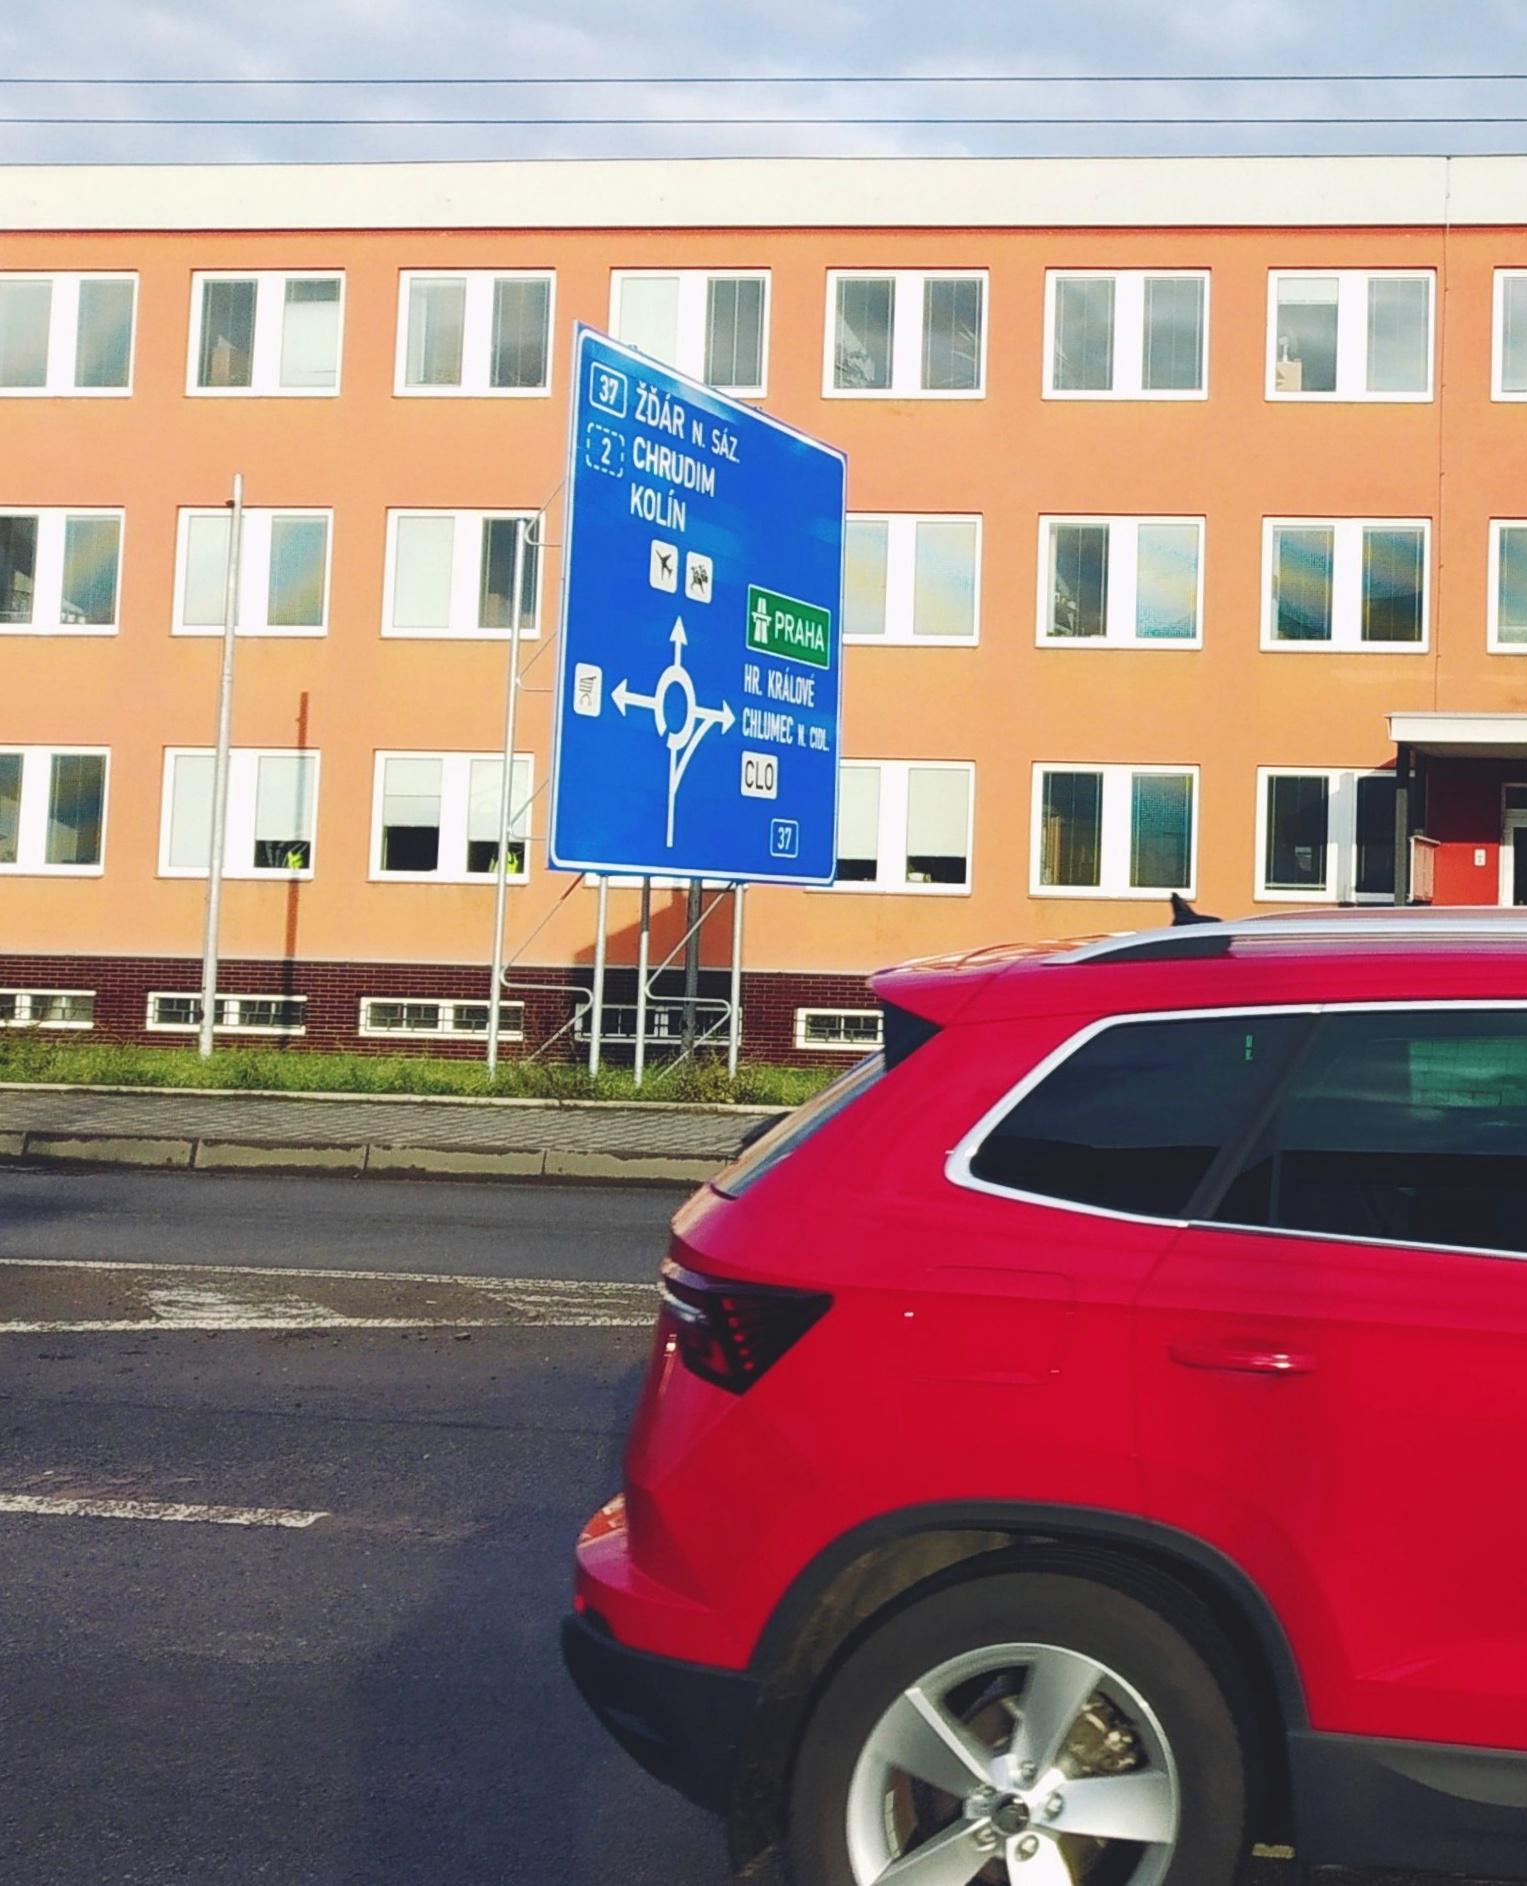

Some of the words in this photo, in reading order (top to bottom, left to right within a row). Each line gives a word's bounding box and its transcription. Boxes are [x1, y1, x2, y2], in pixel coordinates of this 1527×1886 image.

[599, 374, 618, 405] 37
[635, 380, 685, 439] ŽĎÁR
[692, 420, 706, 448] N.
[712, 428, 740, 463] SÁZ.
[601, 438, 612, 464] 2
[633, 436, 716, 497] CHRUDIM
[630, 483, 686, 532] KOLÍN
[774, 611, 824, 651] PRAHA
[744, 663, 763, 696] HR.
[767, 666, 815, 708] KRÁLOVÉ
[742, 707, 794, 743] CHLUMEC
[810, 726, 829, 751] CIDL.
[745, 760, 773, 790] CLO
[777, 827, 791, 849] 37
